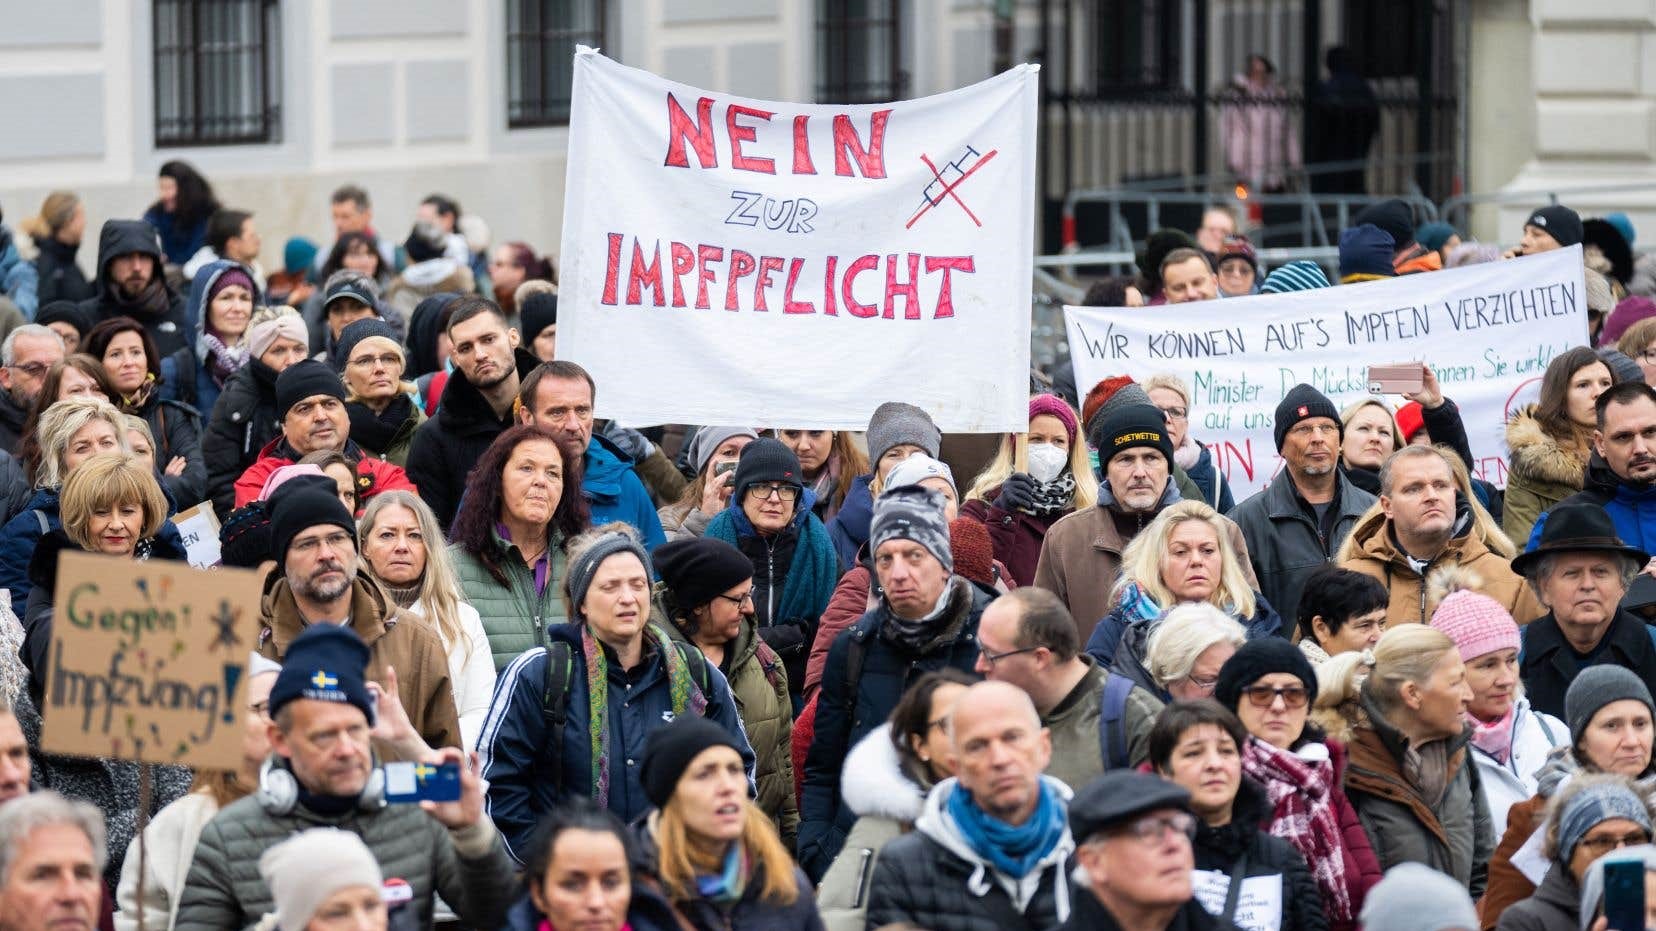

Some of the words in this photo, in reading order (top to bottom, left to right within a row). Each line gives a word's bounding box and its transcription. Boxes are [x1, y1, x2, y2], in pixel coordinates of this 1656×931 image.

[664, 91, 893, 179] NEIN
[725, 190, 818, 233] ZUR
[601, 232, 975, 320] IMPFPFLICHT
[1077, 322, 1130, 359] WIR
[1148, 327, 1246, 359] KÖNNEN
[1265, 318, 1330, 352] AUF'S
[1344, 304, 1430, 345] IMPFEN
[1445, 281, 1577, 331] VERZICHTEN
[1194, 370, 1264, 405] Minister
[1279, 367, 1296, 400] D
[1312, 365, 1369, 394] Mückst
[1413, 354, 1475, 382] önnen
[1483, 347, 1507, 378] Sie
[1205, 406, 1232, 430] auf
[1205, 438, 1253, 482] IN
